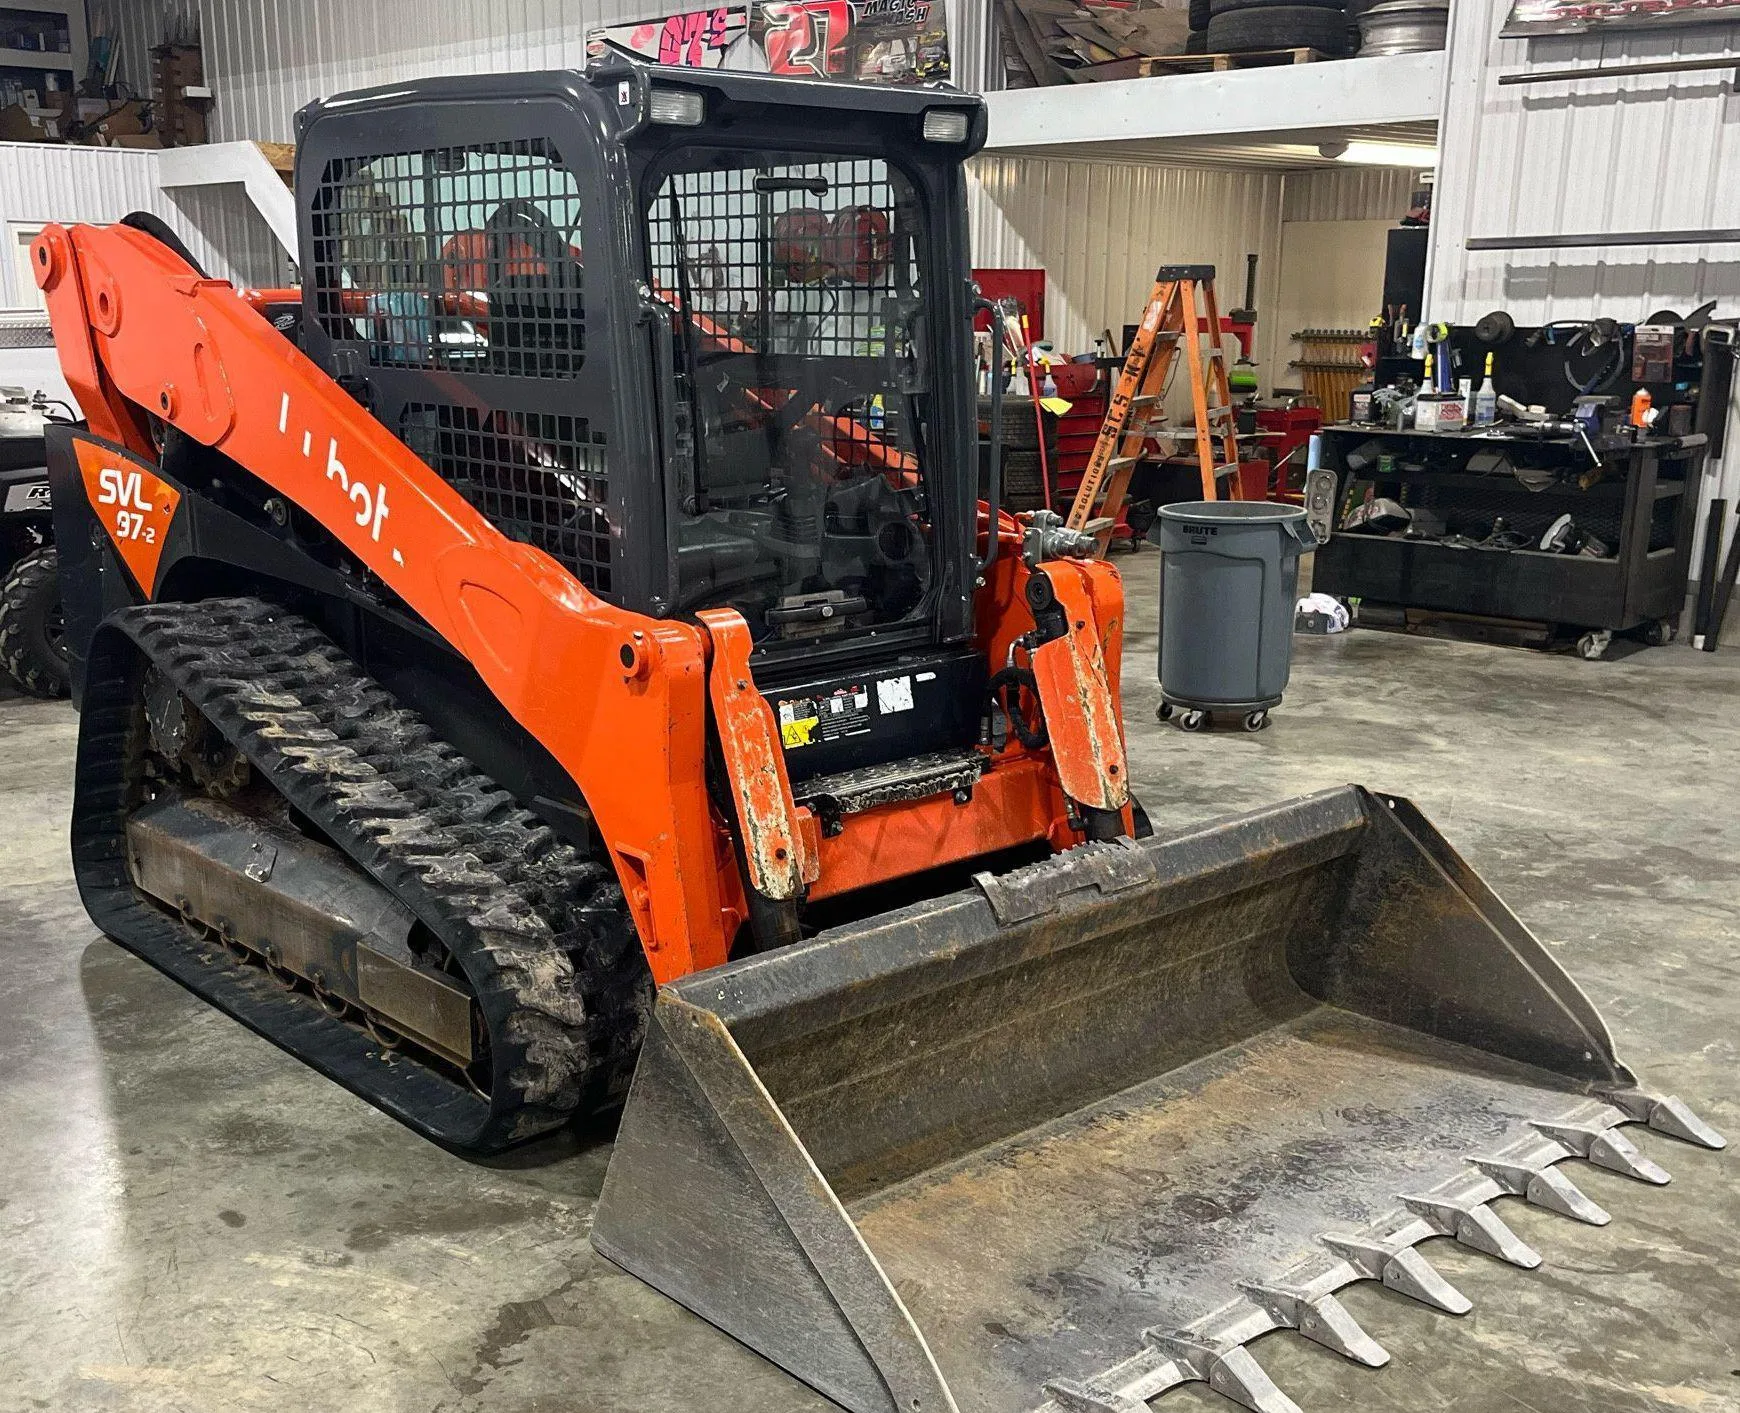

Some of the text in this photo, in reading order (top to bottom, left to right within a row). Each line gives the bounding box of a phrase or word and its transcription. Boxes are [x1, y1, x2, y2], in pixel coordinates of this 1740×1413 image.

[98, 468, 152, 512] SVL
[116, 510, 155, 544] 97-2
[1182, 525, 1218, 536] BRUTE
